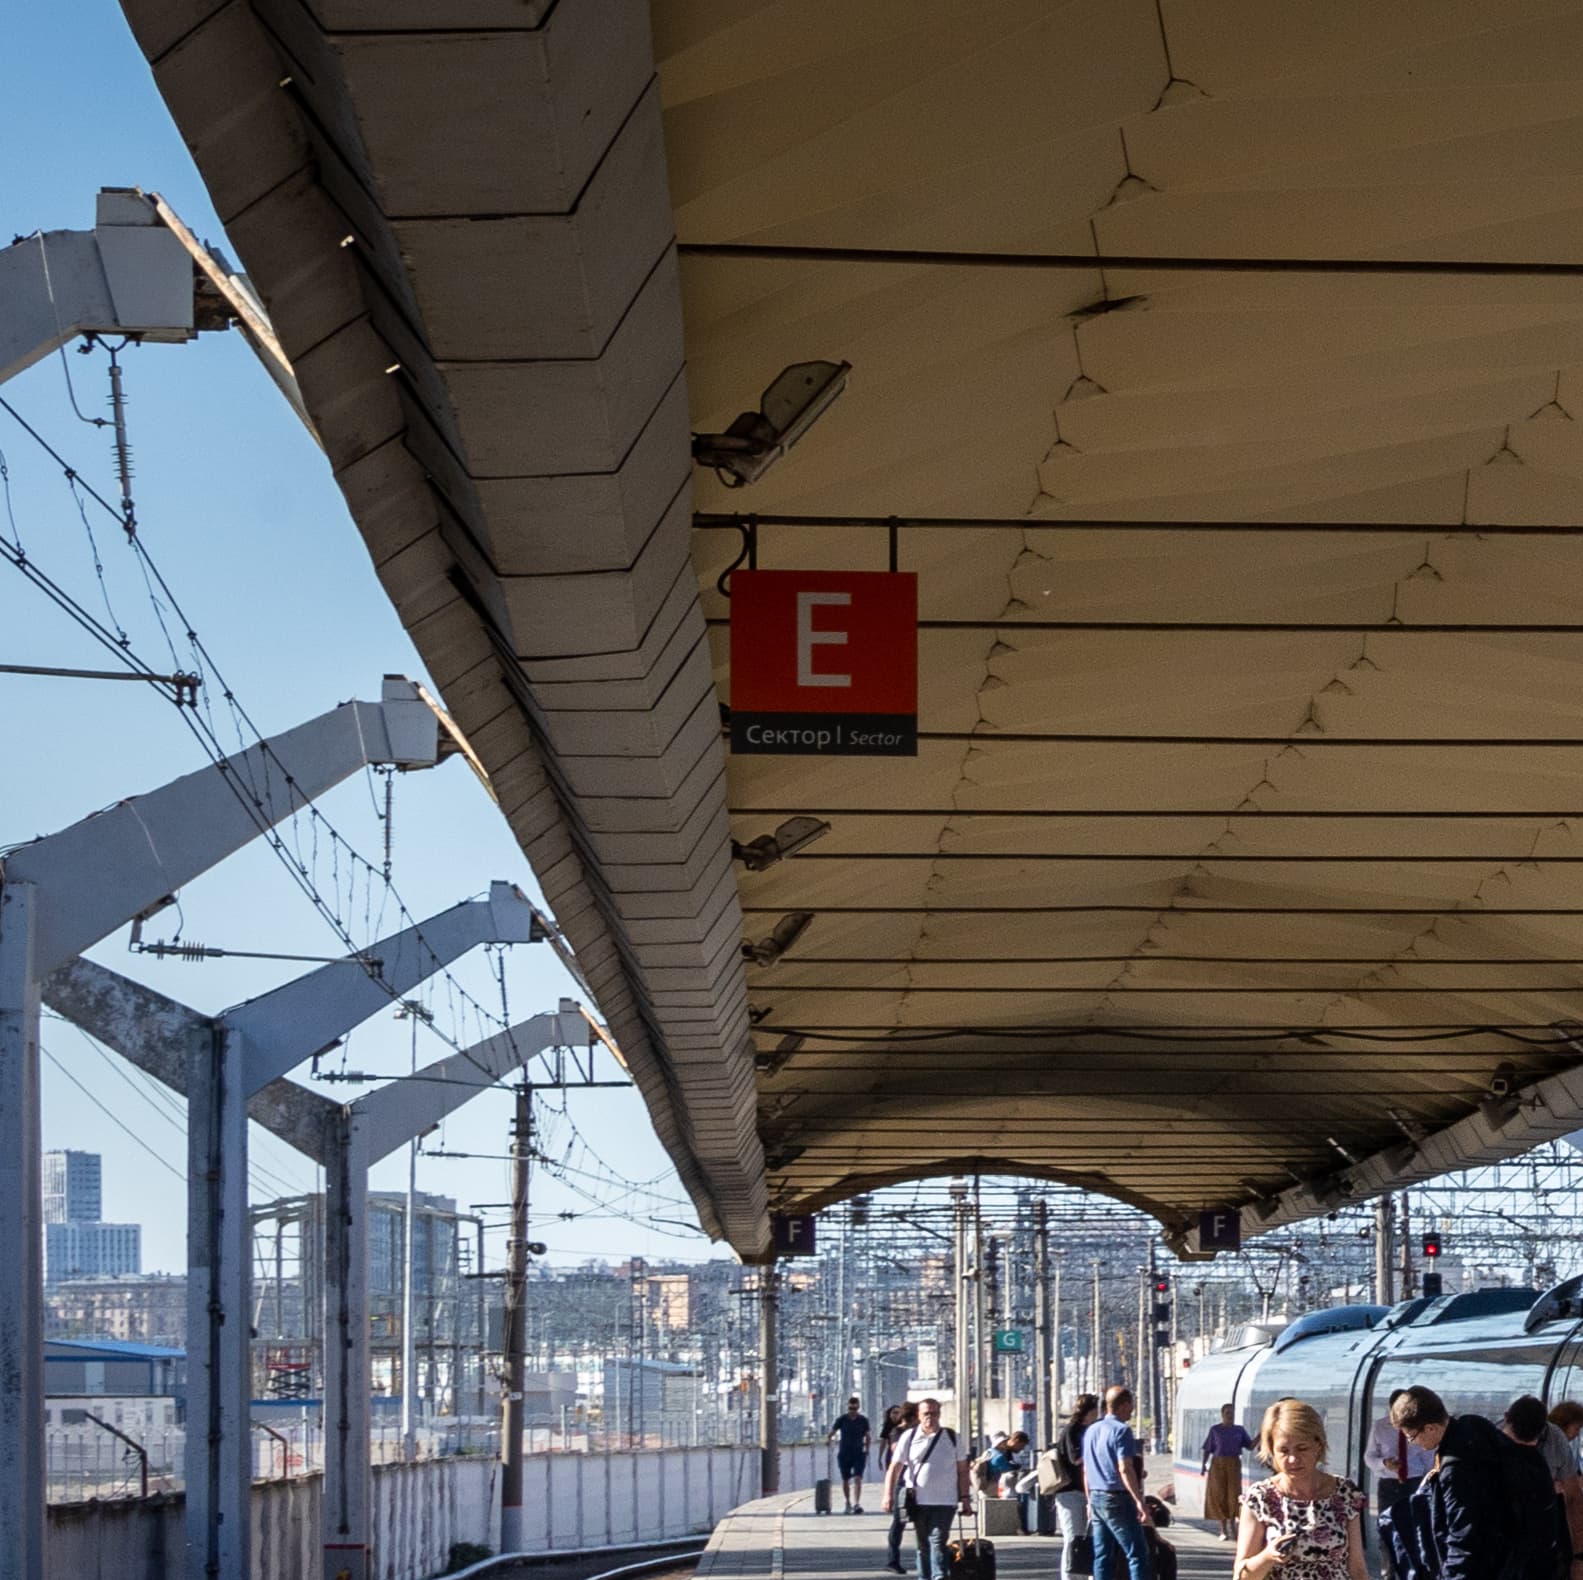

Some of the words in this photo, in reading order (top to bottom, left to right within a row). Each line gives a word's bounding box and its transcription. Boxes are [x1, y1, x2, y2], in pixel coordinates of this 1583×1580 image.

[797, 591, 852, 687] E
[746, 725, 831, 749] Сектор
[849, 730, 903, 746] Sector
[789, 1221, 802, 1243] F
[1213, 1216, 1225, 1238] F
[1003, 1332, 1016, 1346] G
